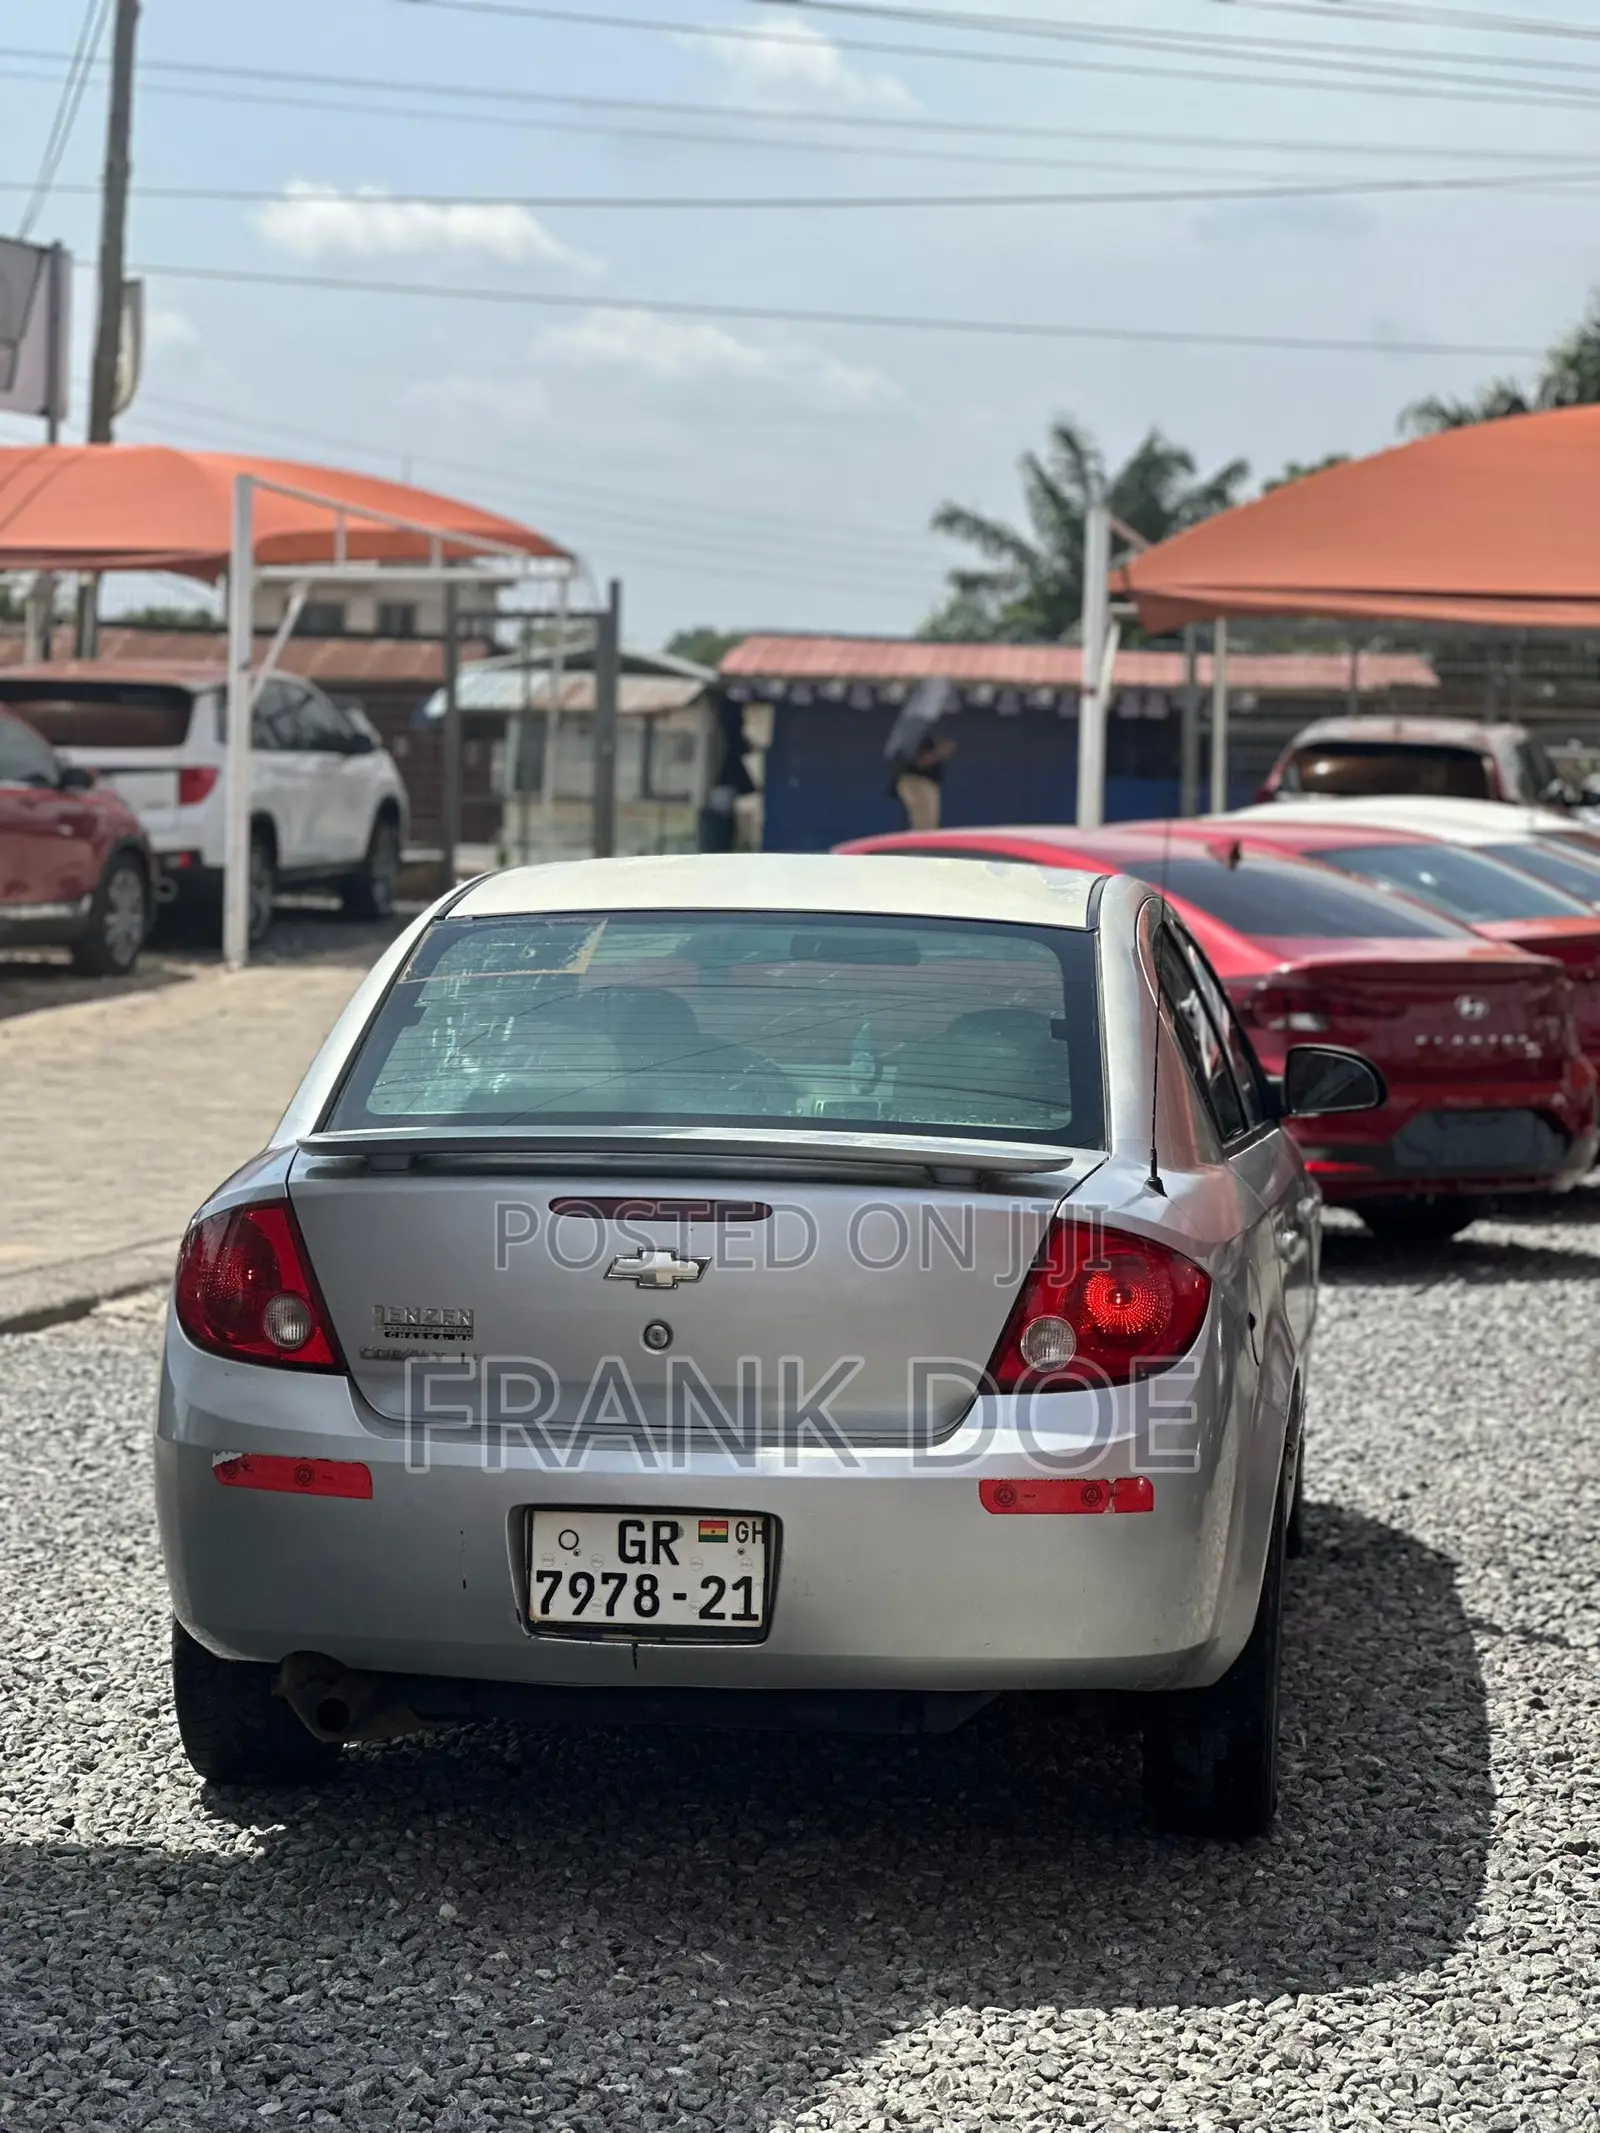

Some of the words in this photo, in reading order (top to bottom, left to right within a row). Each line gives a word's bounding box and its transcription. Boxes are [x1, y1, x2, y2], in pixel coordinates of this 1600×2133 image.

[618, 1519, 680, 1565] GR
[735, 1520, 765, 1544] GH
[536, 1570, 759, 1621] 7978-21
